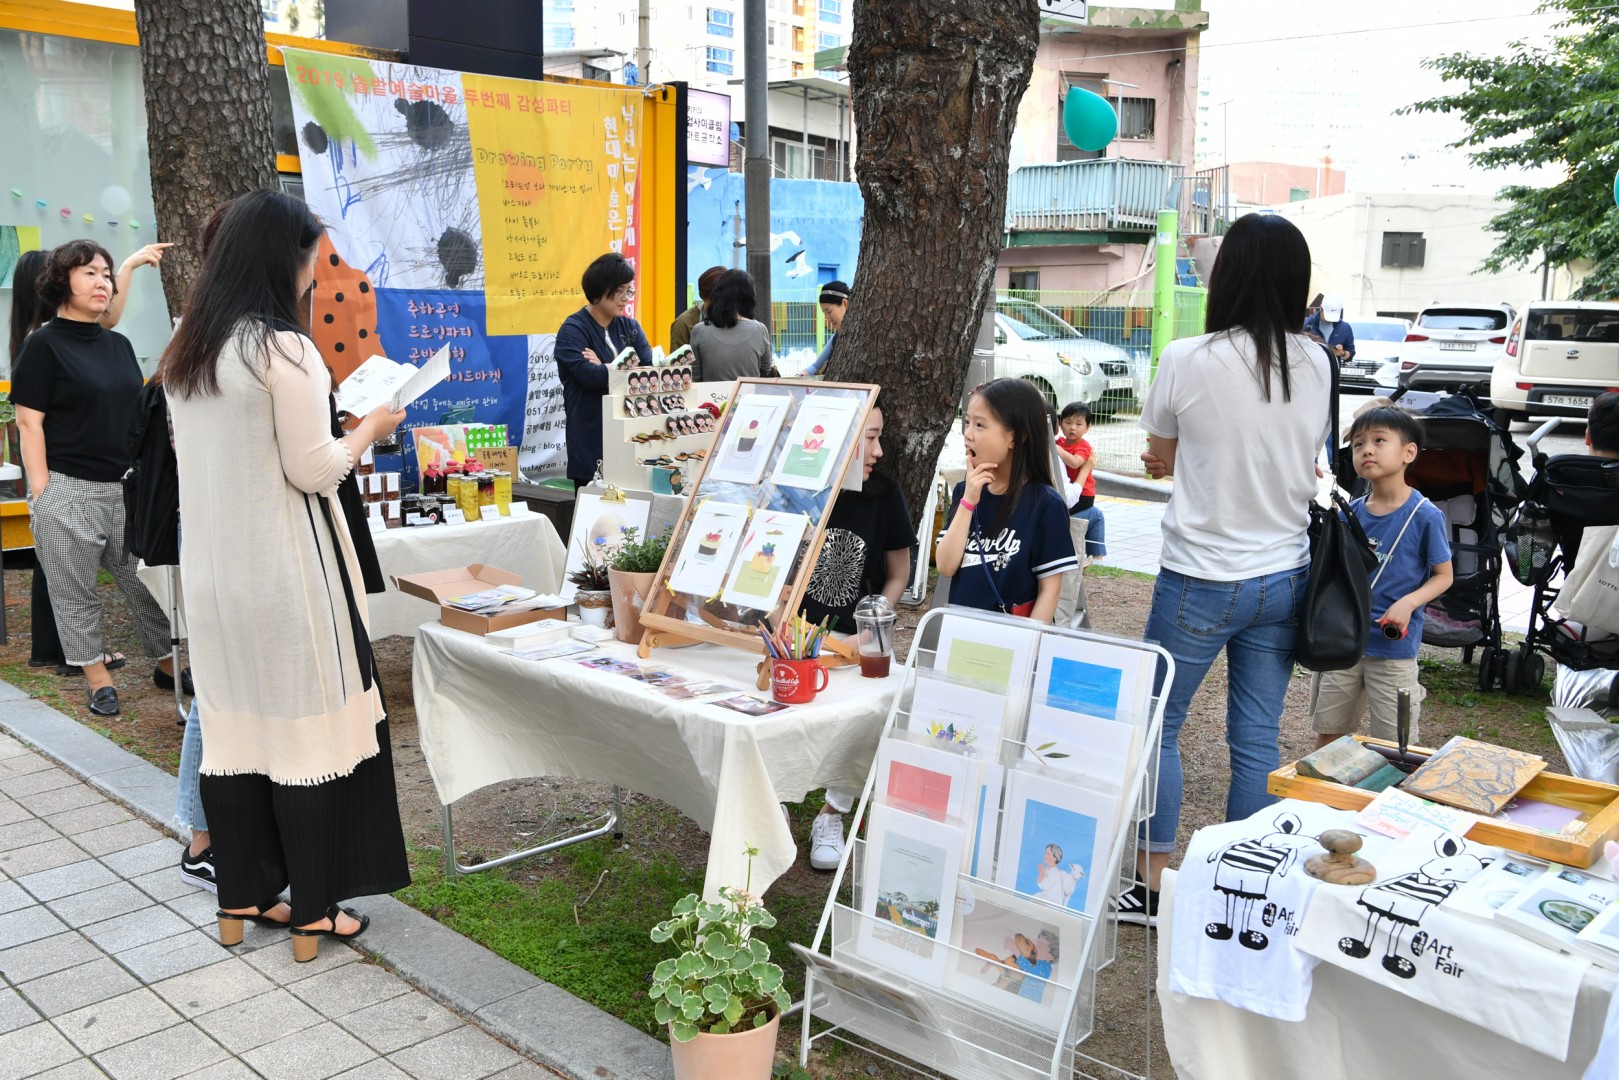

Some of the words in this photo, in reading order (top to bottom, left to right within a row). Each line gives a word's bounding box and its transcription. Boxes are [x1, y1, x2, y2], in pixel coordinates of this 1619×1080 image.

[295, 66, 345, 89] 2019
[464, 89, 511, 111] 두번째
[517, 95, 571, 117] 감성파티
[476, 148, 546, 171] Drawing
[549, 154, 593, 174] Party
[407, 300, 461, 319] 축하공연
[408, 325, 474, 341] 드로잉파티
[408, 346, 465, 363] 공방험
[1567, 397, 1588, 405] 1654
[521, 444, 537, 454] blog
[519, 461, 557, 473] instagram
[1598, 579, 1617, 592] LOTTE
[1426, 938, 1454, 959] Art
[1435, 956, 1464, 979] Fair
